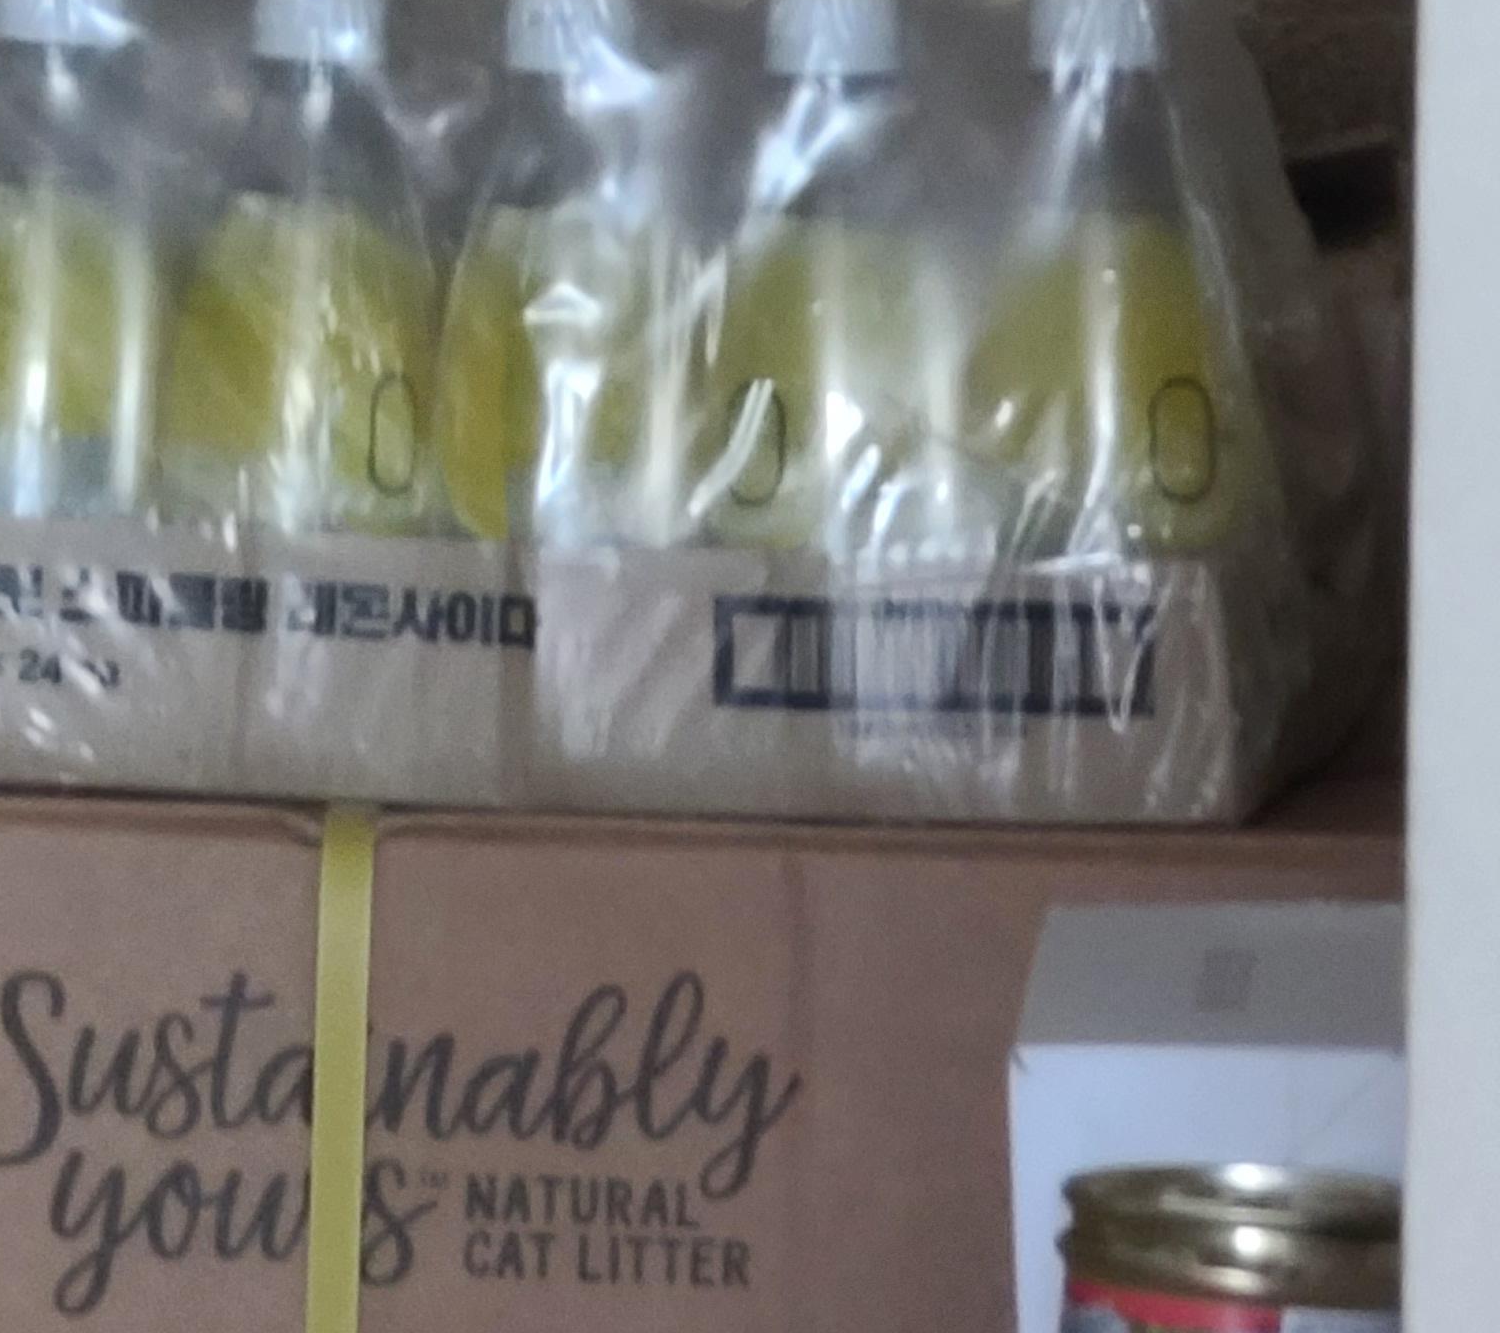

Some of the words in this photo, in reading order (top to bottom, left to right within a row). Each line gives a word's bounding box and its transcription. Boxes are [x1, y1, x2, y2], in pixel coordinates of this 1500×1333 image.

[465, 1173, 699, 1227] NATURAL
[47, 1147, 438, 1318] yous
[464, 1230, 555, 1280] CAT
[577, 1233, 752, 1287] LITTER
